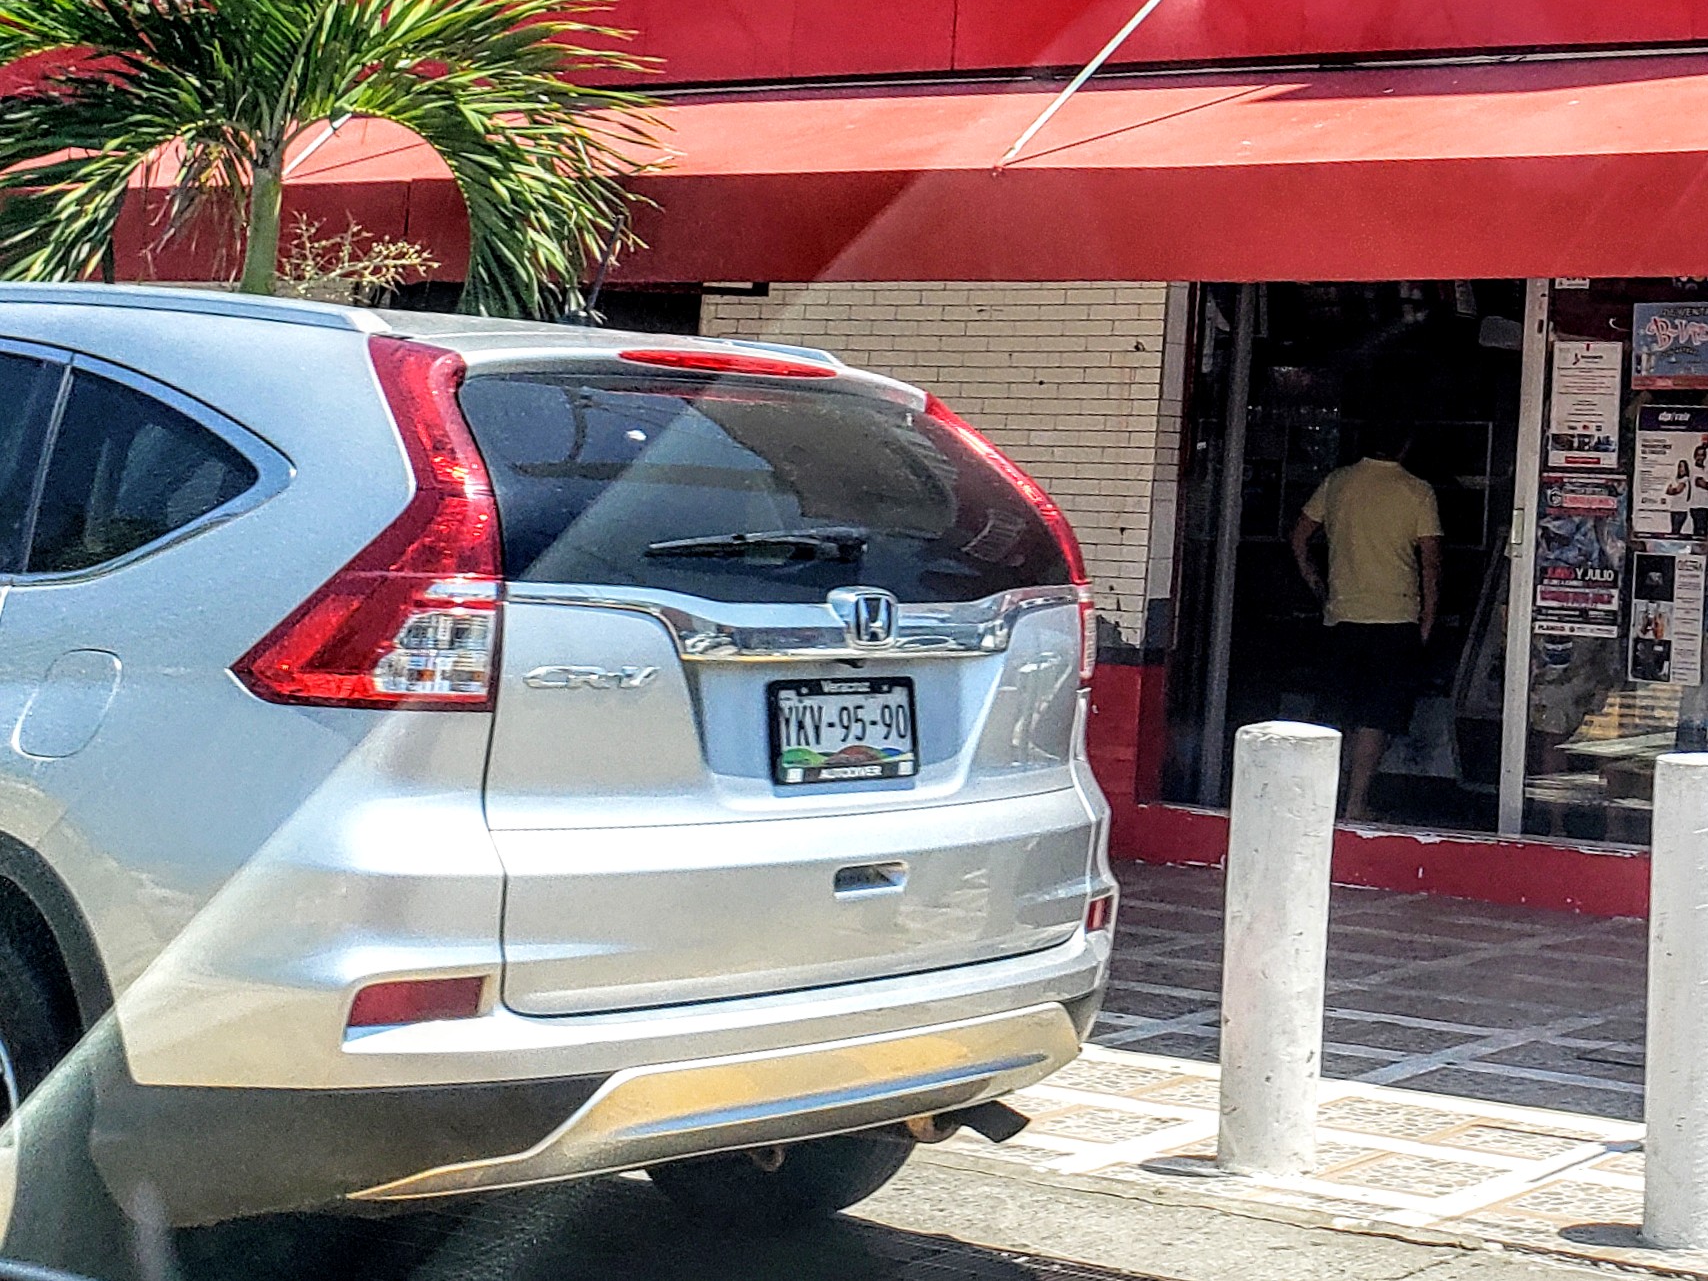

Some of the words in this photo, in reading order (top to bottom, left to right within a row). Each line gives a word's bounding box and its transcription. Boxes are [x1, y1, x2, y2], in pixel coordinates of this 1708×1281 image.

[1575, 568, 1585, 580] Y
[1585, 568, 1615, 582] JULIO
[522, 665, 661, 690] CR-V
